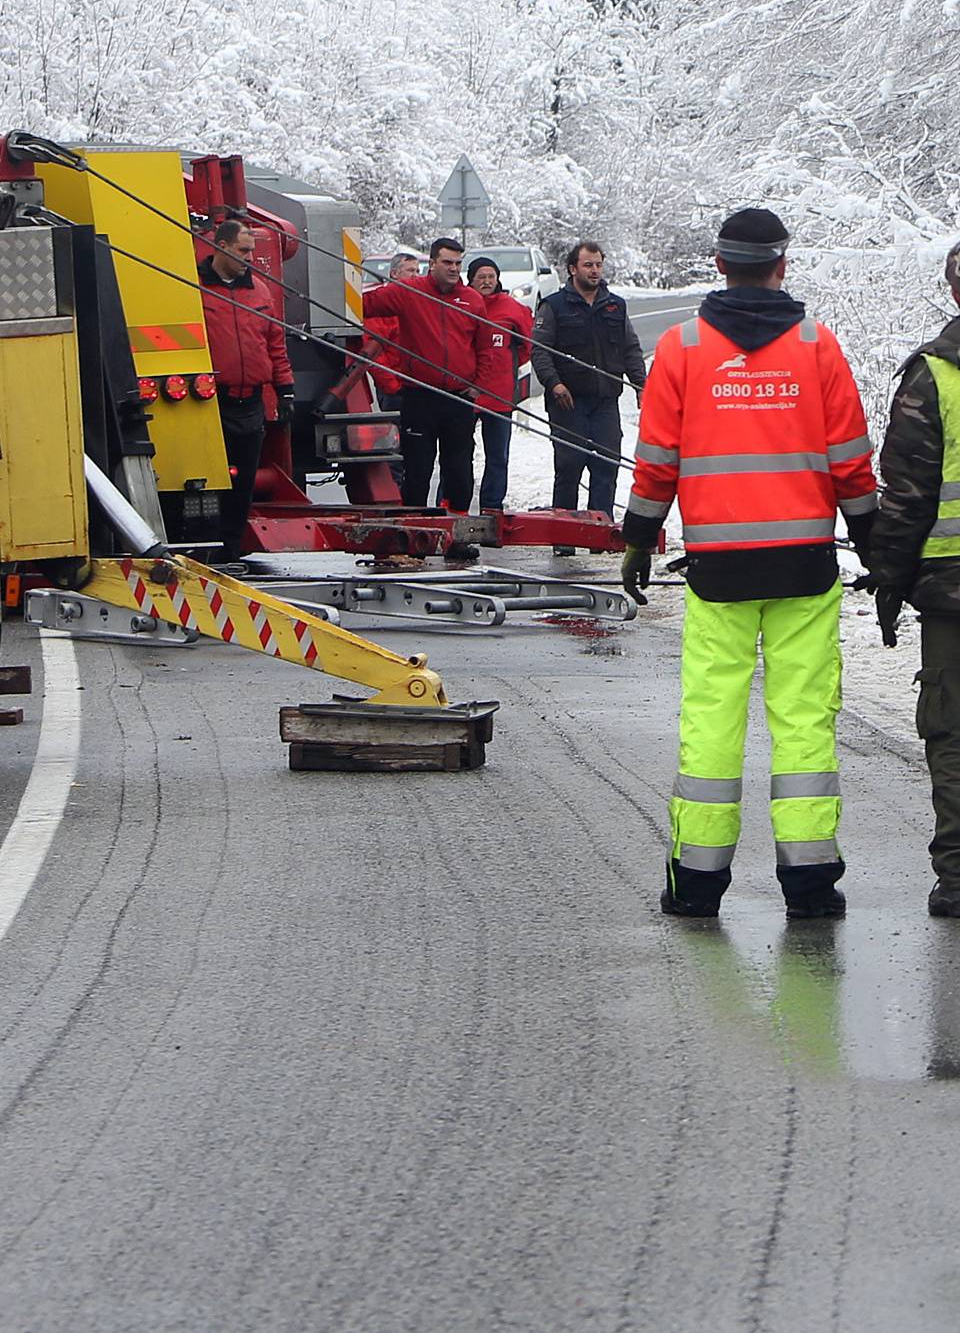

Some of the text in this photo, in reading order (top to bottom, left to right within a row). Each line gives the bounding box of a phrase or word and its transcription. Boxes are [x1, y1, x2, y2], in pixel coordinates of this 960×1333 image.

[711, 383, 800, 397] 0800 18 18
